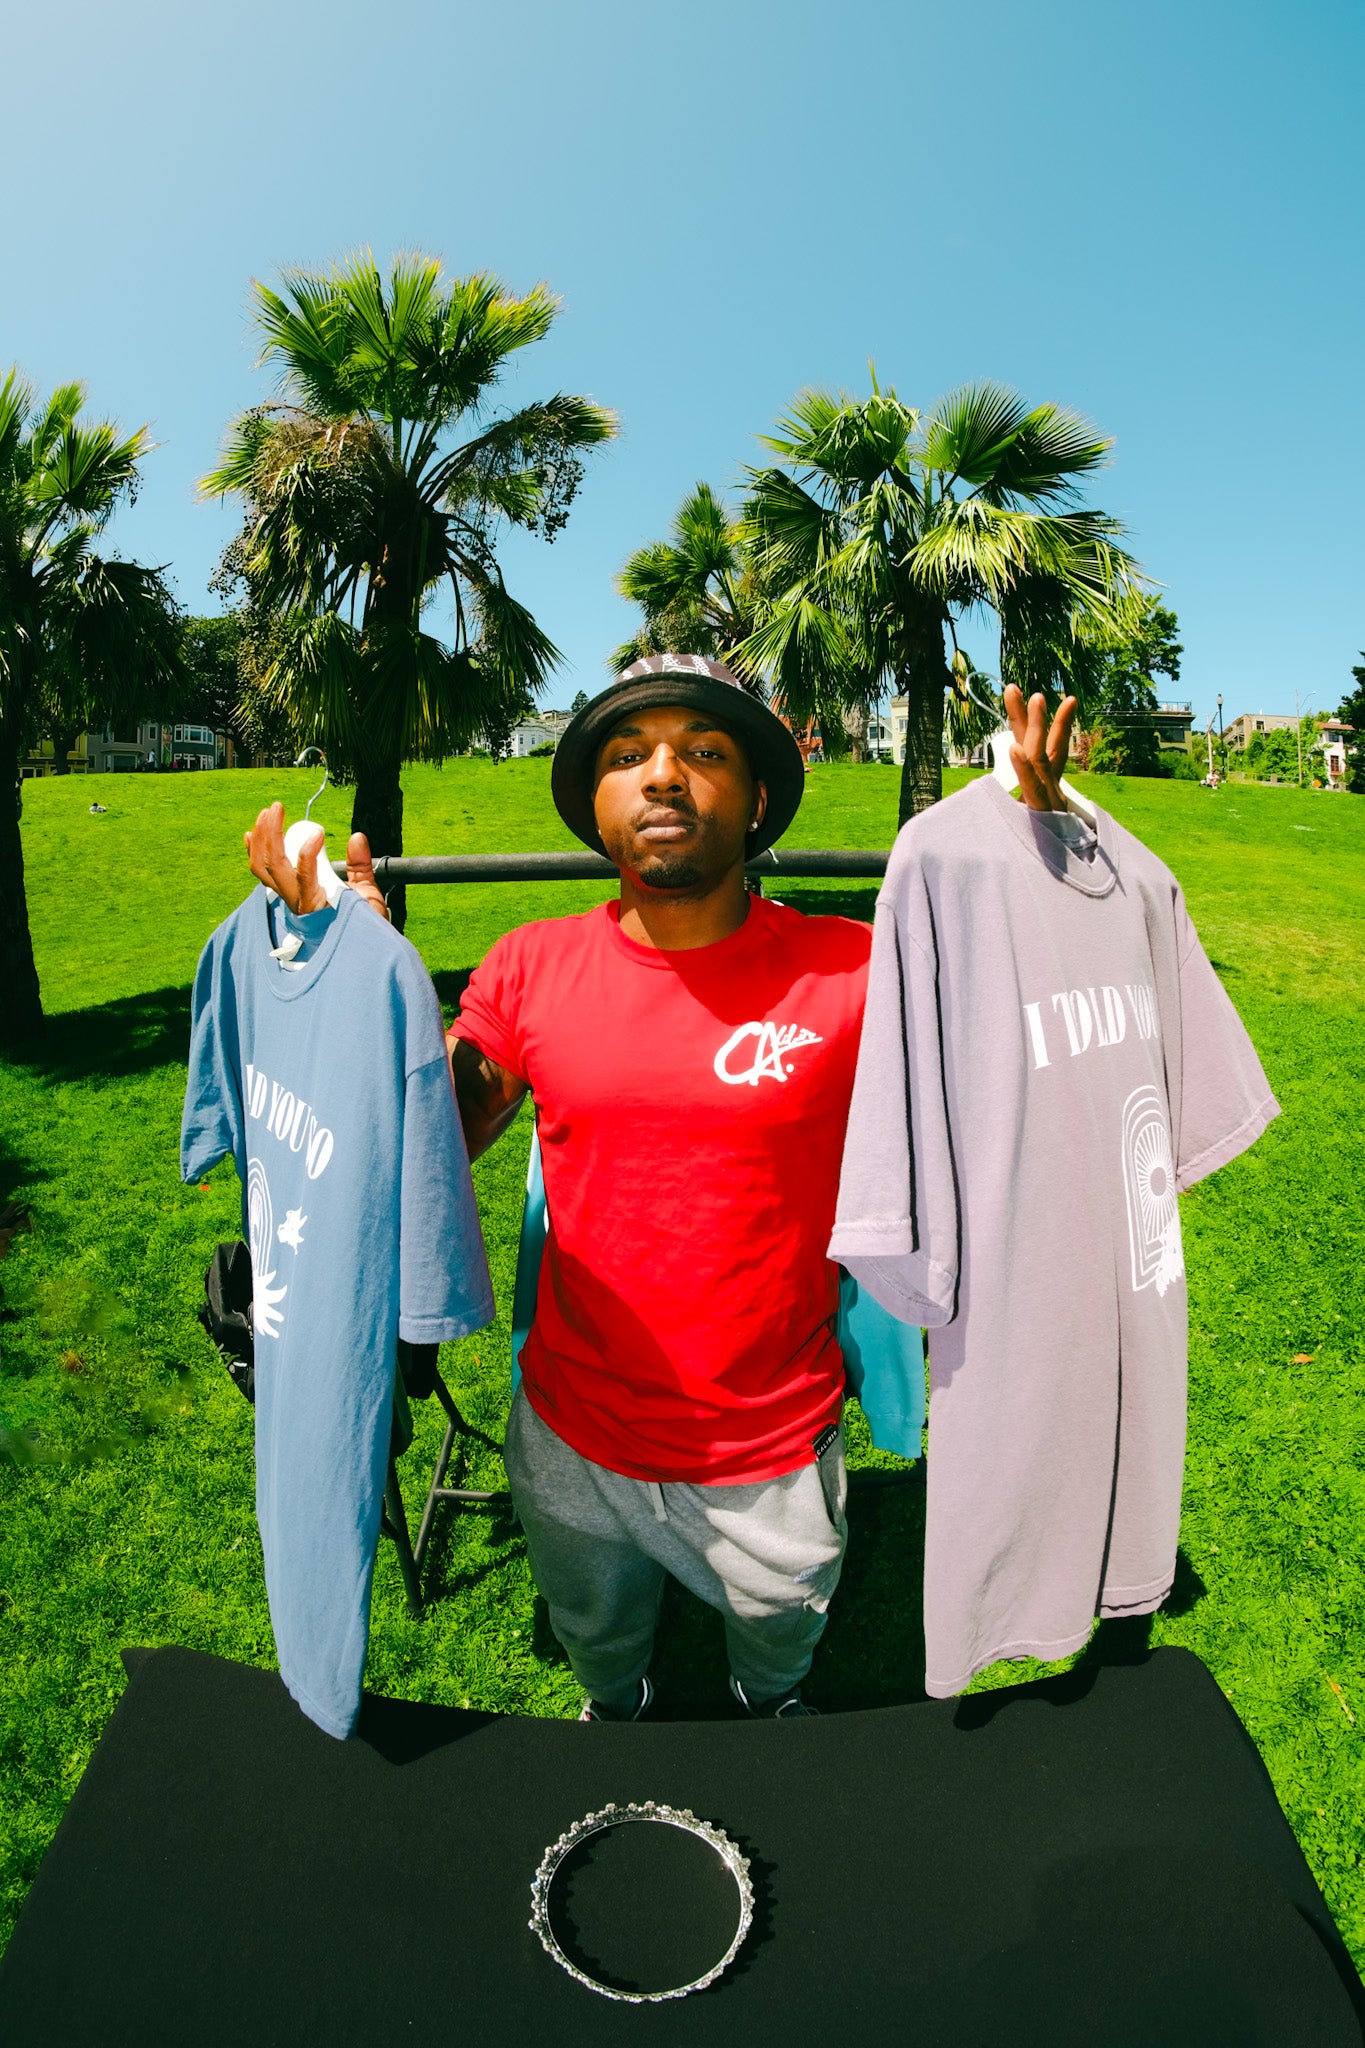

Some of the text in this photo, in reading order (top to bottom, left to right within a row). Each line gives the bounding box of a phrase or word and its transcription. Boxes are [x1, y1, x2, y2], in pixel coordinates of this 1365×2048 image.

[1022, 1001, 1052, 1070] I
[1051, 985, 1127, 1057] TOLD
[266, 1080, 313, 1153] YOU
